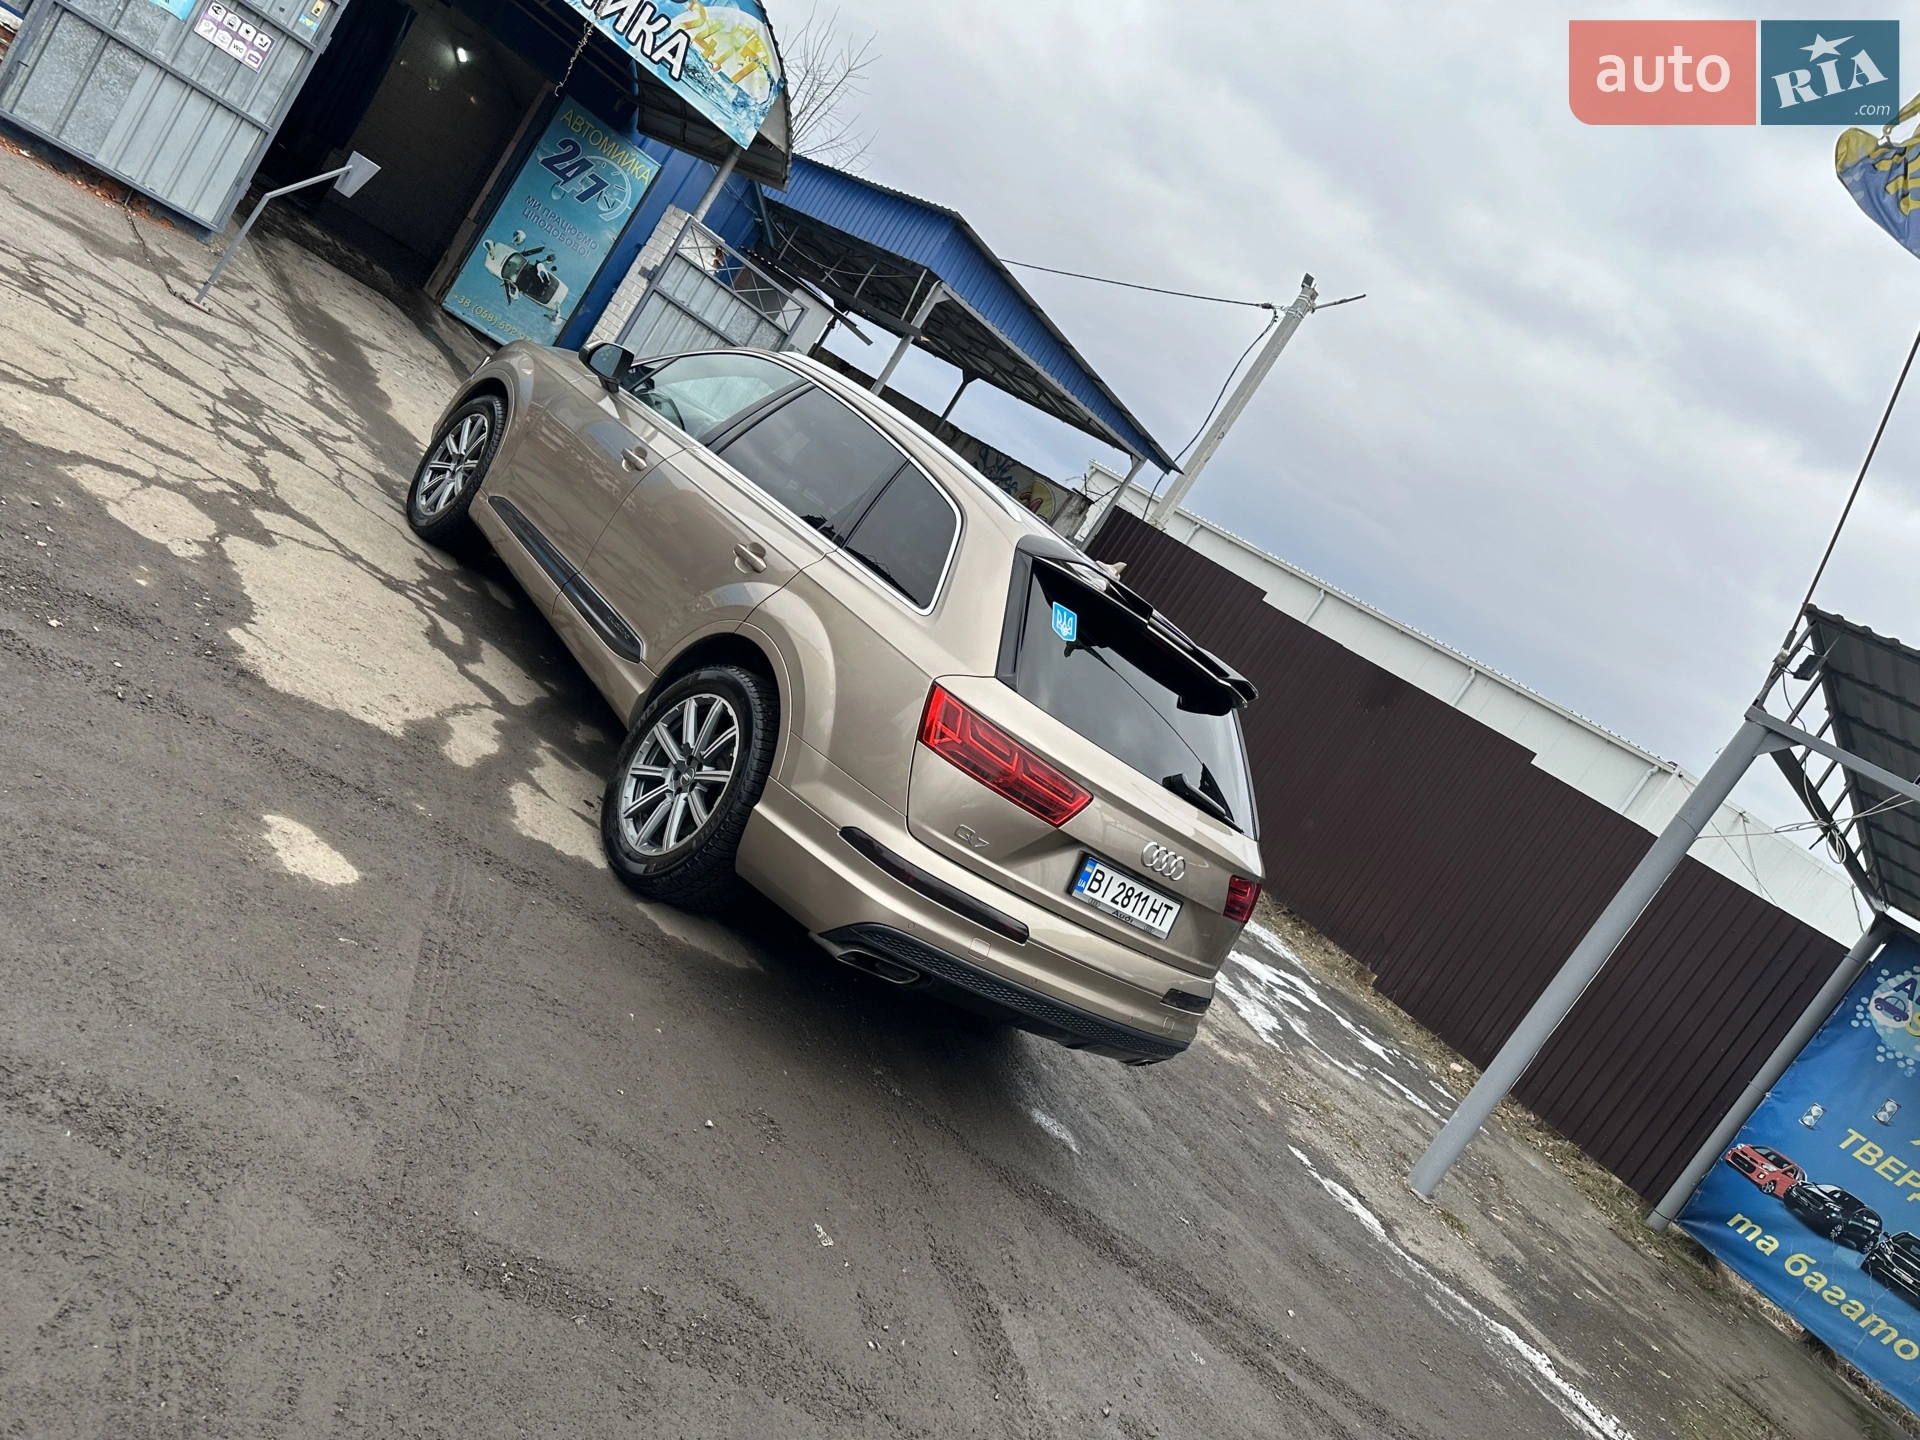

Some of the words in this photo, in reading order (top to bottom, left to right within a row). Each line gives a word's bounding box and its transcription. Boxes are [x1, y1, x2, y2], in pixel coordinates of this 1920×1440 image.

[233, 43, 244, 54] WC
[560, 109, 651, 186] АВТОМИЙКА
[525, 195, 543, 212] МИ
[954, 824, 990, 848] Q7
[1078, 878, 1087, 889] UA
[1110, 881, 1151, 917] 2811
[1112, 910, 1134, 924] Audi
